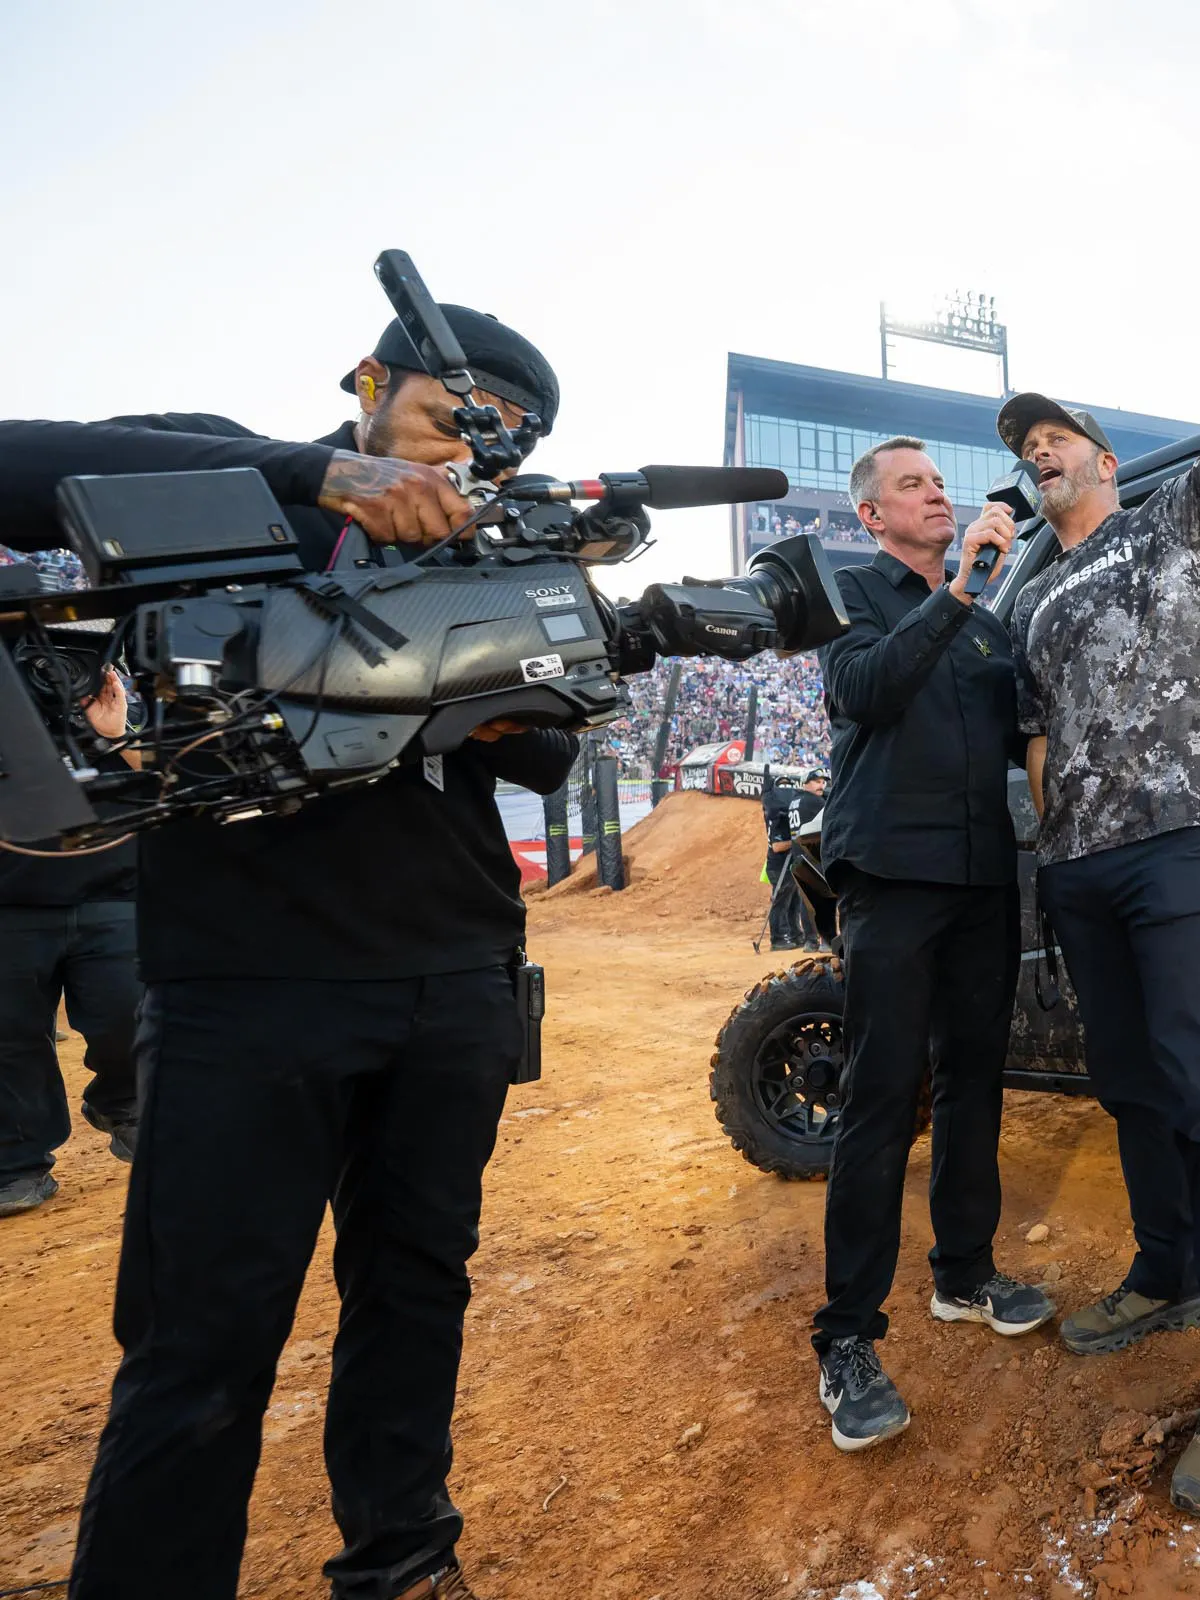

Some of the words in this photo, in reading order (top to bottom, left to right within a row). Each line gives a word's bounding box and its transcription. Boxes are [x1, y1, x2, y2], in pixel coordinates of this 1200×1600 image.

[1033, 541, 1133, 618] awasaki
[525, 585, 571, 598] SONY
[705, 624, 738, 636] Canon
